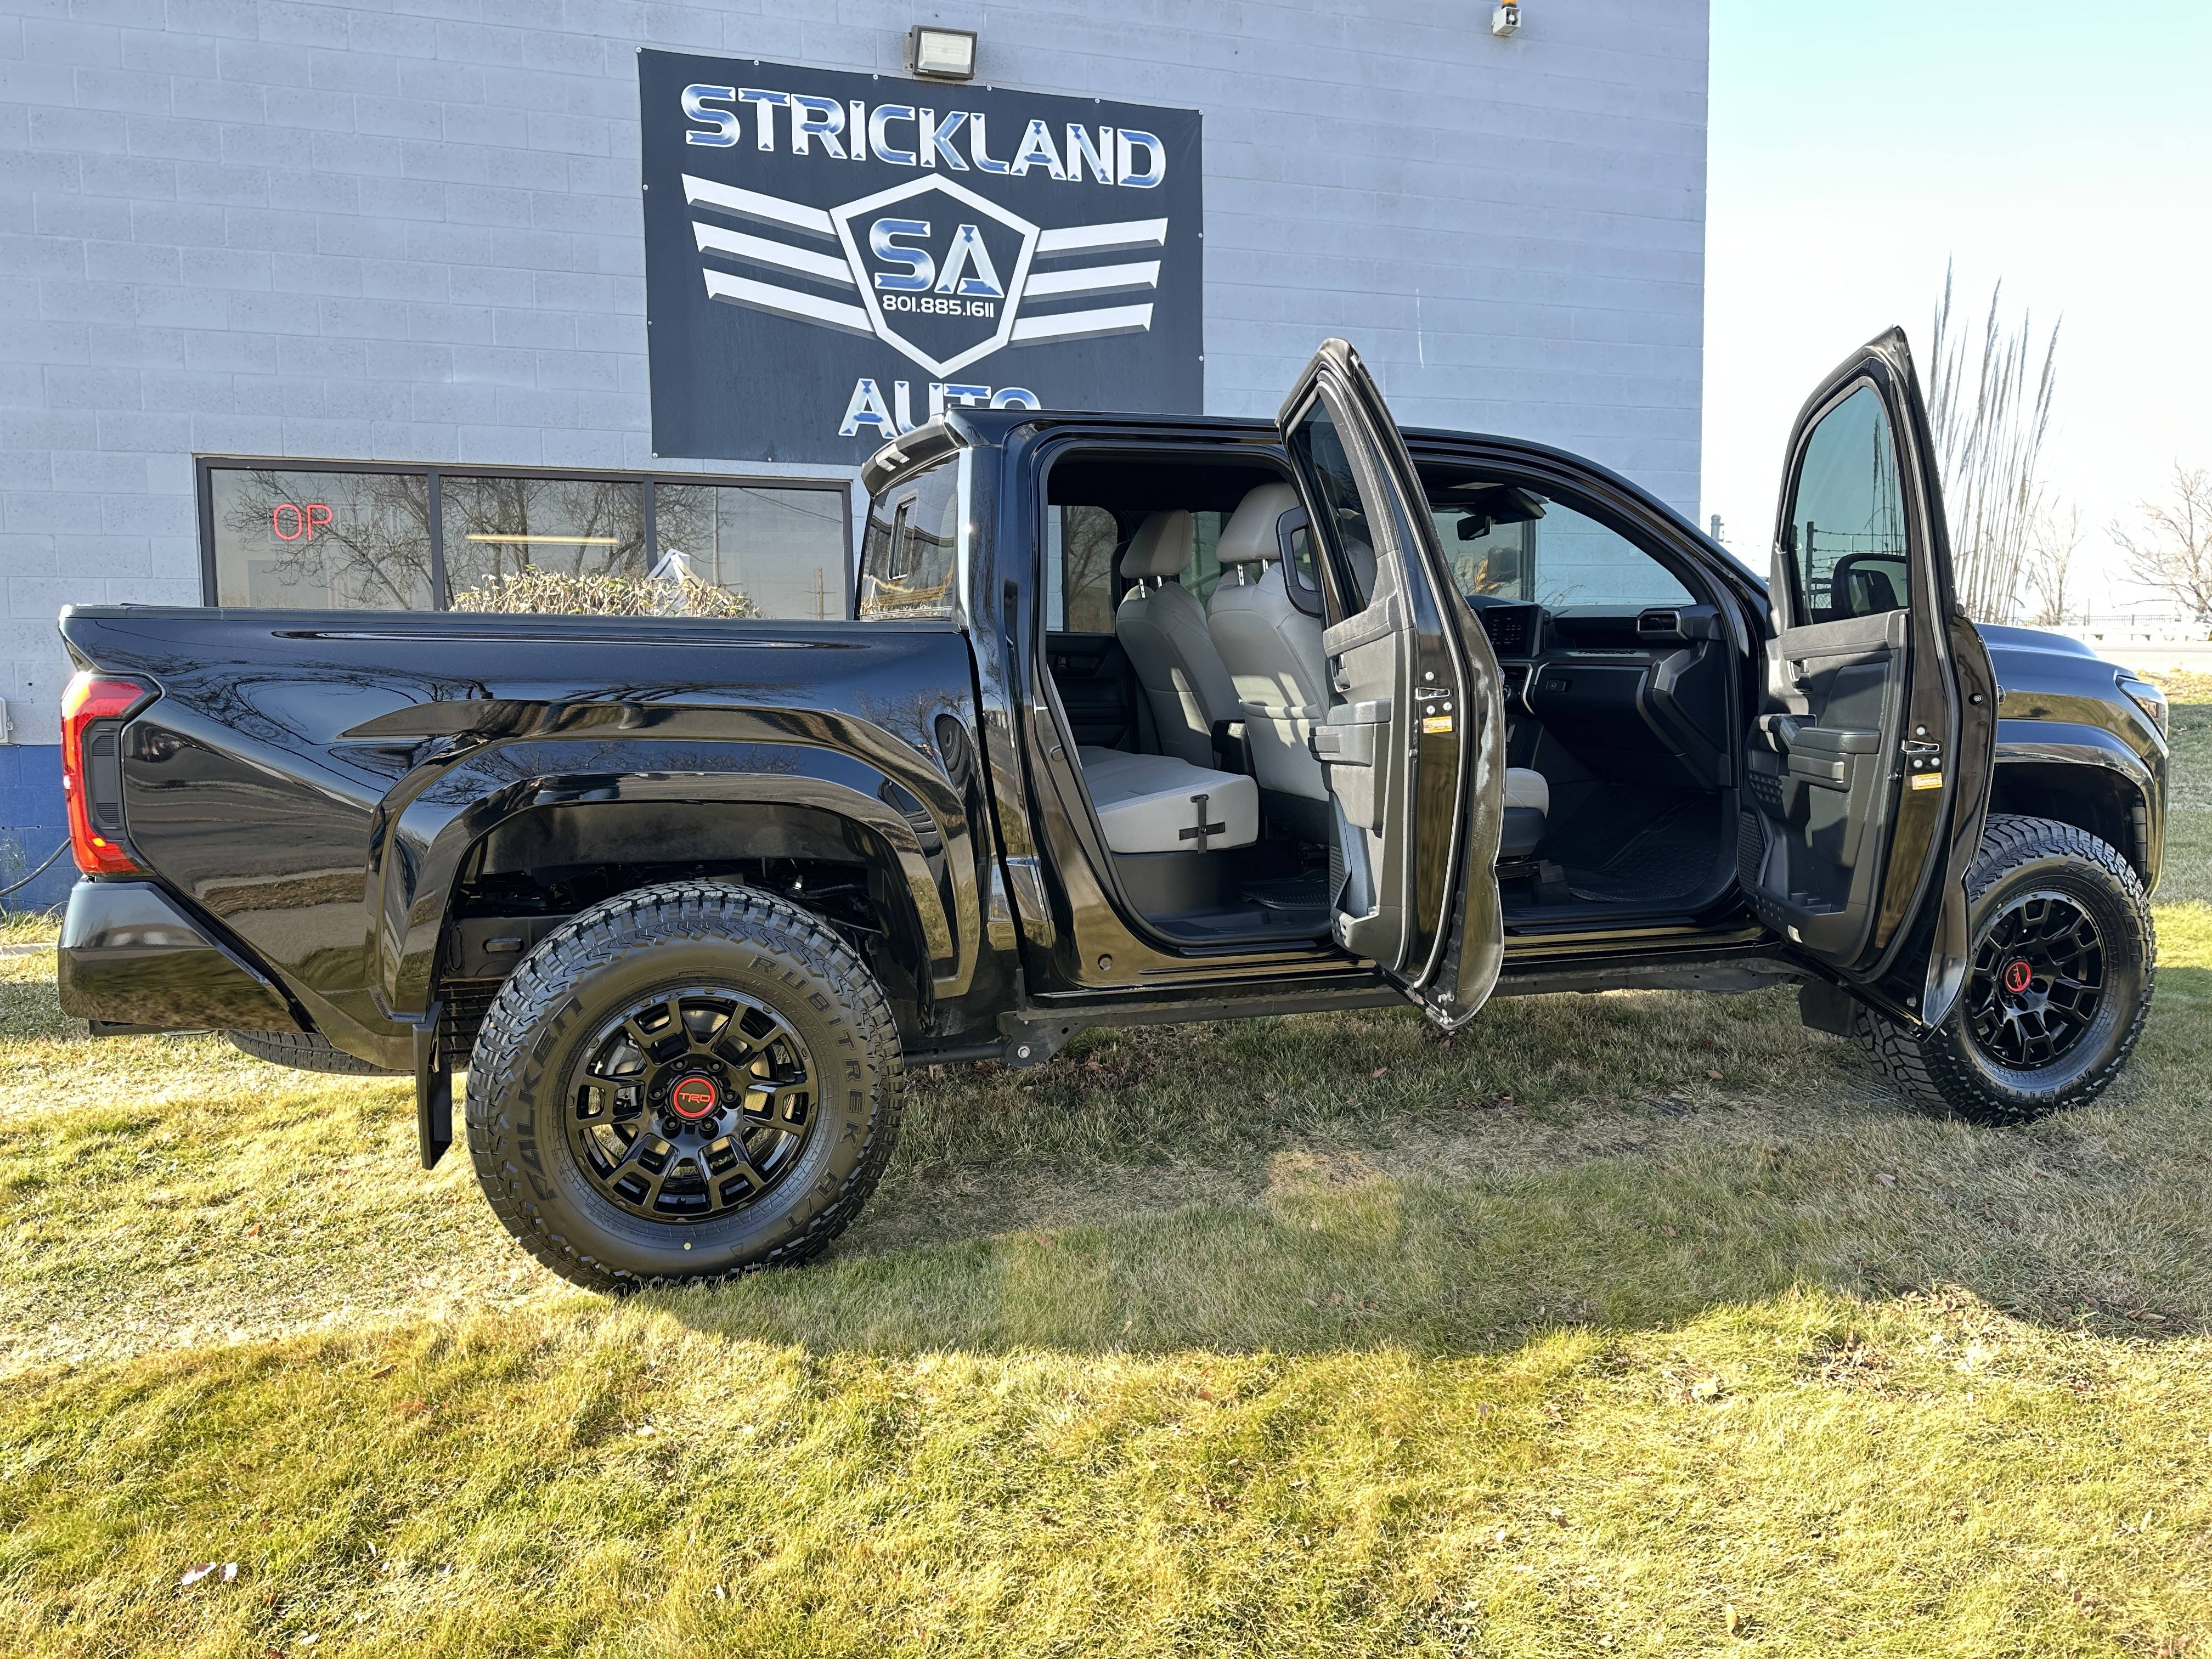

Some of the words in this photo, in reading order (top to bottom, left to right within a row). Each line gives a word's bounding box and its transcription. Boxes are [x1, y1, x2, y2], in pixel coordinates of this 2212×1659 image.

[681, 83, 1166, 189] STRICKLAND
[869, 218, 1005, 298] SA
[883, 295, 994, 318] 801.885.1611
[2013, 965, 2022, 988] TRD
[748, 953, 865, 1149] RUBITREK
[517, 996, 584, 1207] FALKEN
[679, 1092, 711, 1104] TRD
